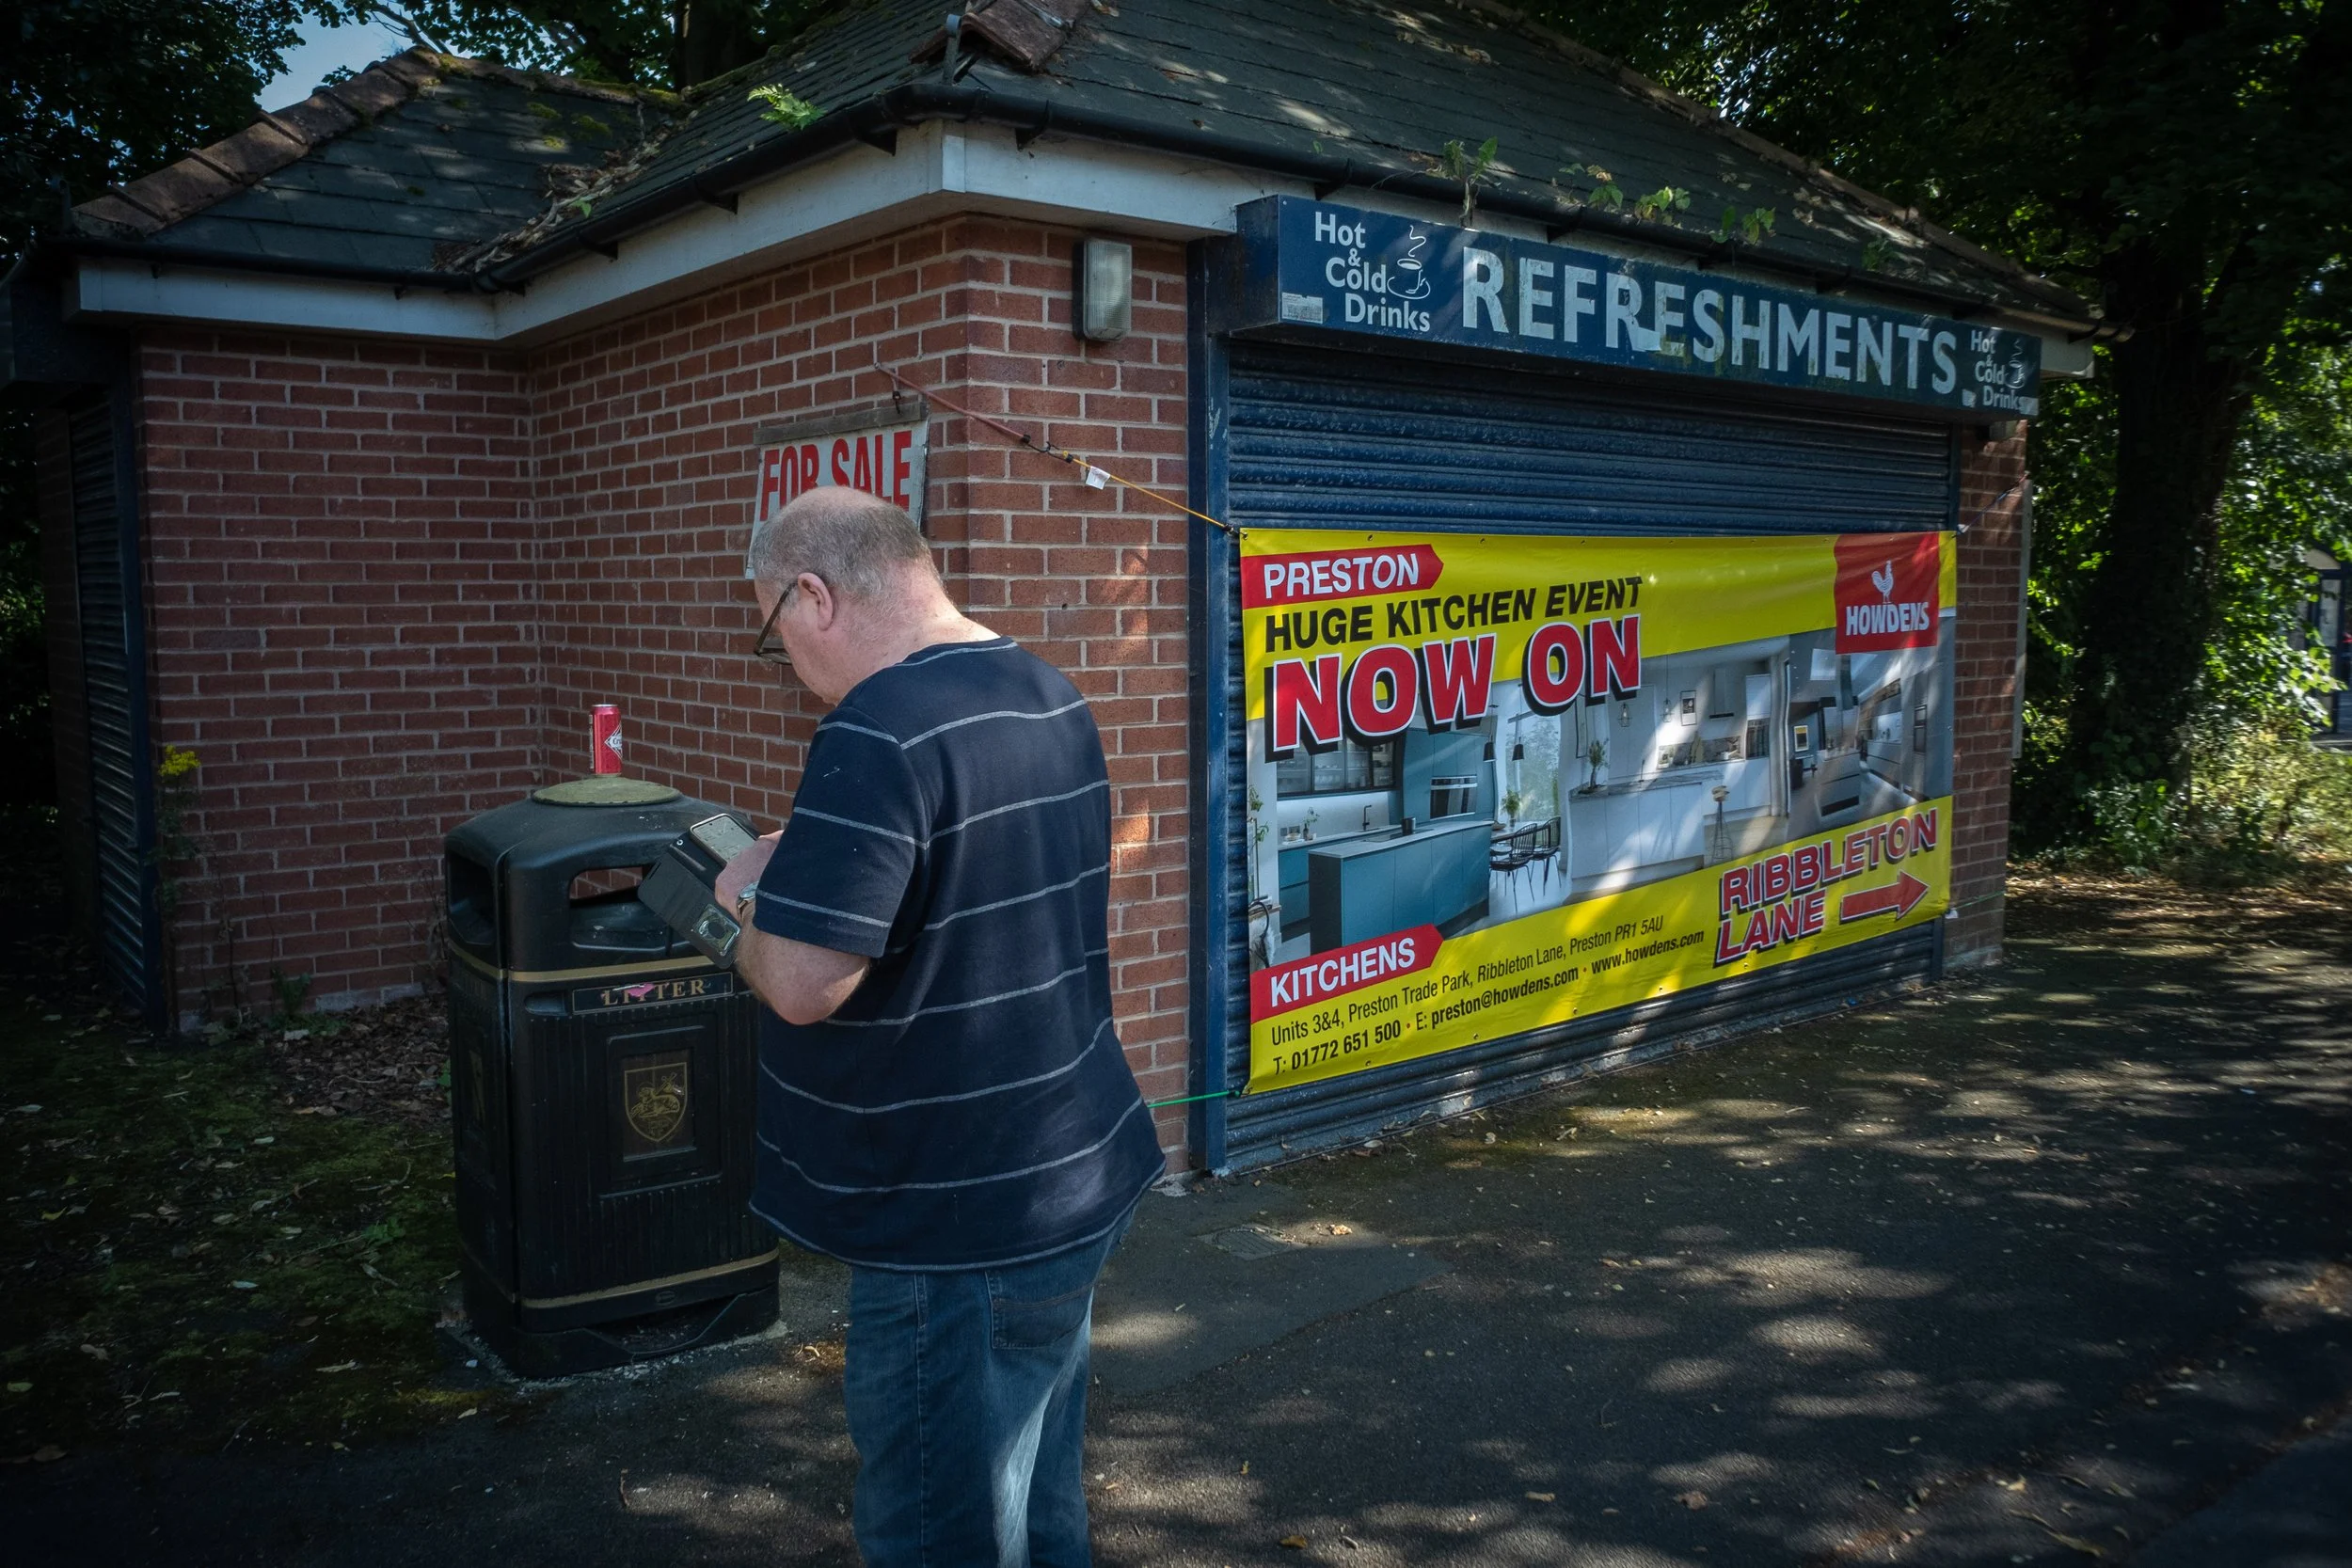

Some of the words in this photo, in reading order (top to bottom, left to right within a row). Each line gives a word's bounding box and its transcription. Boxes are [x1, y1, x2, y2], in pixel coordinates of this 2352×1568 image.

[1315, 211, 1365, 248] Hot
[1348, 248, 1360, 267] &
[1326, 257, 1386, 293] Cold
[1345, 293, 1430, 332] Drinks
[1462, 246, 1957, 394] REFRESHMENTS
[1970, 329, 1995, 354] Hot
[1986, 355, 1993, 367] &
[1976, 360, 2005, 385] Cold
[760, 444, 819, 521] FOR
[832, 430, 912, 512] SALE
[1264, 553, 1419, 599] PRESTON
[1265, 605, 1374, 653] HUGE
[1387, 587, 1536, 638] KITCHEN
[1545, 576, 1643, 618] EVENT
[1846, 601, 1930, 636] HOWDENS
[1264, 633, 1497, 763] NOW
[1522, 613, 1642, 717] ON
[1719, 807, 1938, 921] RIBBLETON
[1713, 887, 1827, 969] LANE
[1271, 938, 1416, 1007] KITCHENS
[1271, 1020, 1309, 1046] Units
[1312, 1007, 1344, 1034] 3&4,
[1348, 993, 1398, 1022] Preston
[1402, 980, 1438, 1005] Trade
[1441, 970, 1473, 993] Park,
[1477, 954, 1534, 983] Ribbleton
[1536, 943, 1566, 966] Lane,
[1569, 930, 1612, 955] Preston
[1614, 922, 1637, 942] PR1
[1640, 915, 1663, 936] 5AU
[1273, 1056, 1286, 1075] T:
[1292, 1039, 1339, 1069] 01772
[1343, 1029, 1369, 1053] 651
[1375, 1020, 1401, 1044] 500
[1415, 1011, 1427, 1031] E:
[1431, 966, 1579, 1029] preston@howdens.com
[1591, 930, 1705, 974] www.howdens.com
